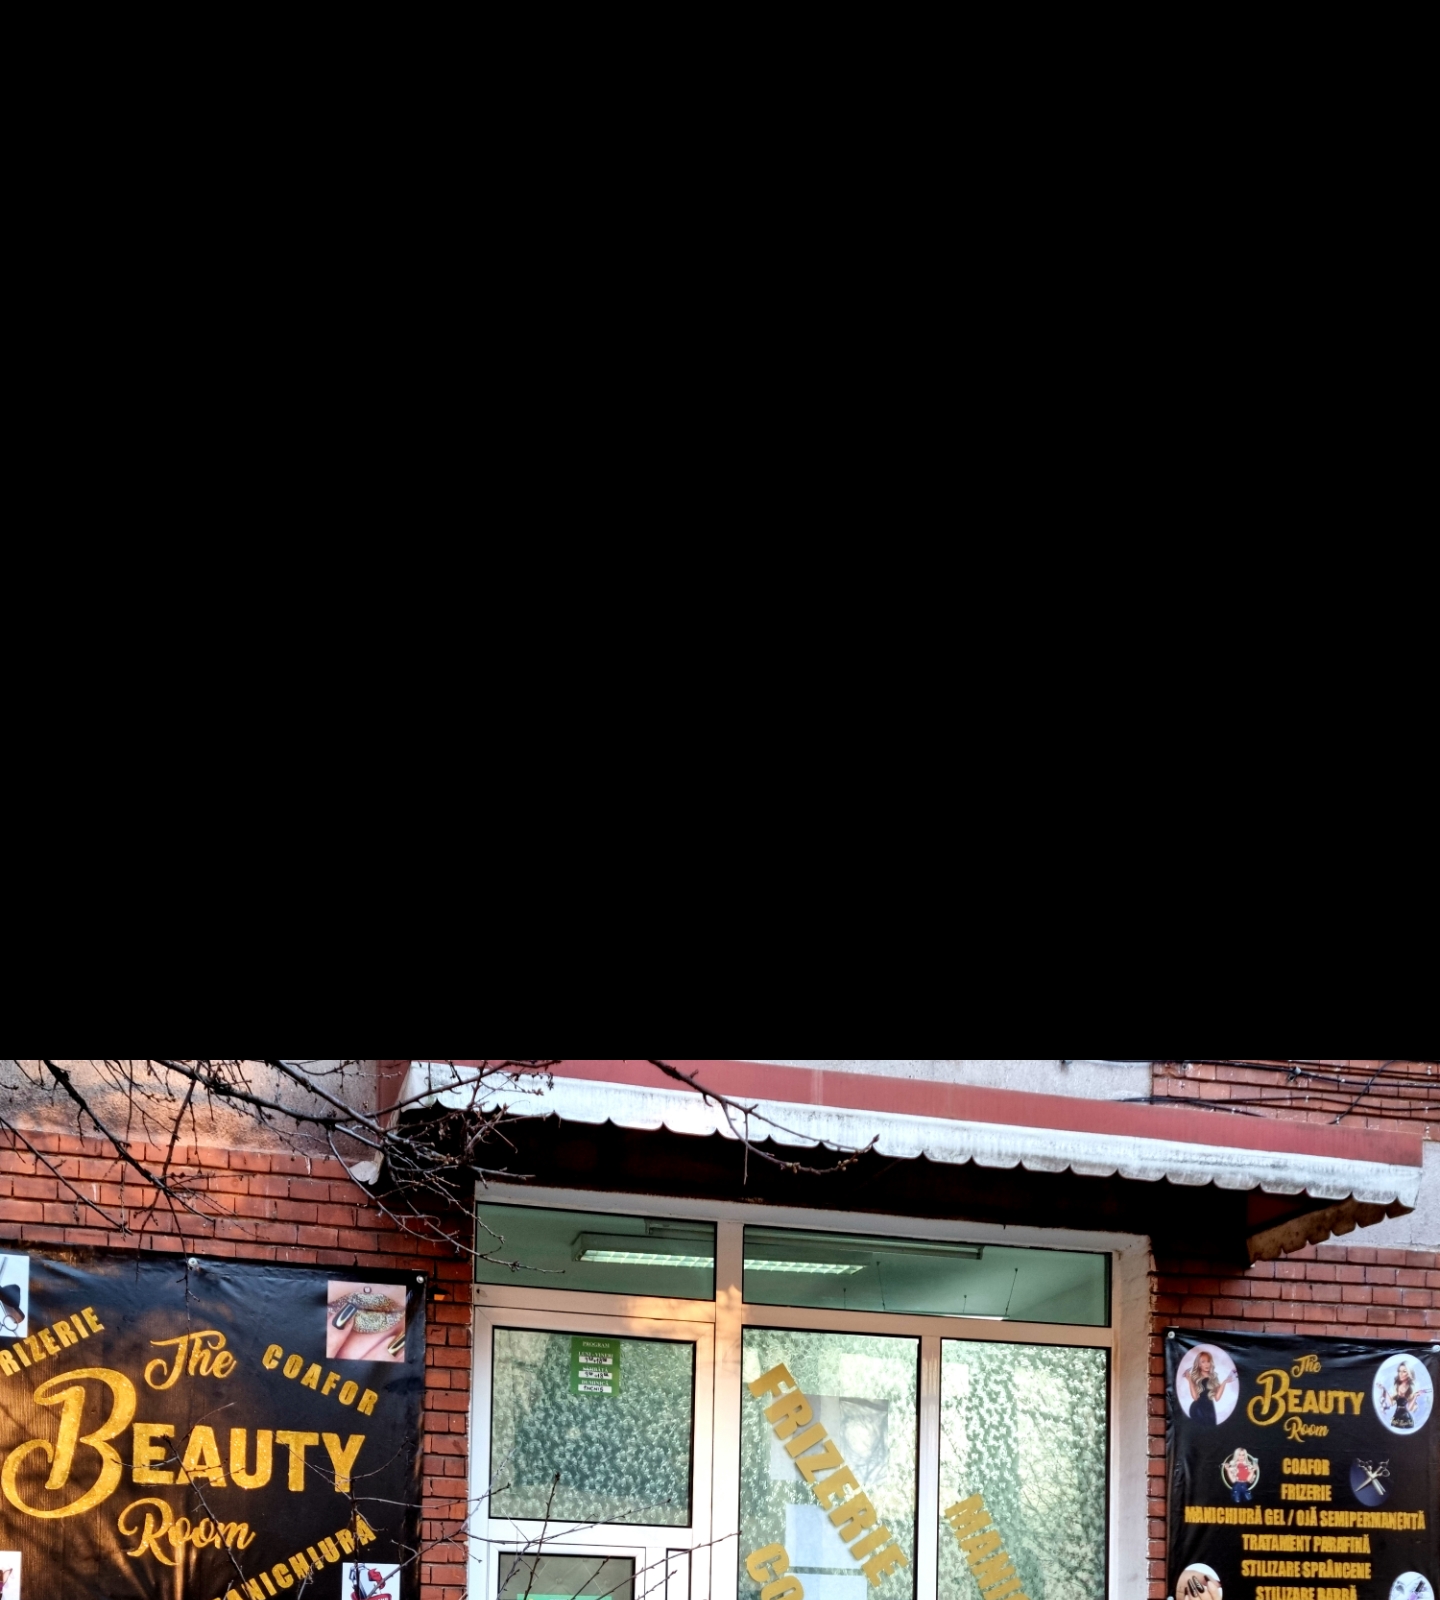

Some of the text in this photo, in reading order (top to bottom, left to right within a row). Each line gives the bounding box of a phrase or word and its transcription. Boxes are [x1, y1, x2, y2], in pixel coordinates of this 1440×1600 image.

[0, 1306, 105, 1377] RIZERIE
[144, 1330, 237, 1390] The
[261, 1343, 379, 1417] COAFOR
[1290, 1354, 1322, 1378] The
[1247, 1369, 1365, 1426] BEAUTY
[1, 1367, 366, 1519] BEAUTY
[1283, 1416, 1329, 1443] Room
[748, 1362, 908, 1587] FRIZERIE
[1282, 1458, 1330, 1476] COAFOR
[1281, 1484, 1332, 1502] FRIZERIE
[117, 1497, 256, 1566] Room
[1184, 1505, 1426, 1530] MANICHIURĂ GEL / OJĂ SEMIPERMANENTĂ
[1242, 1533, 1371, 1554] TRATAMENT PARAFINĂ
[1241, 1558, 1372, 1580] STILIZARE SPRÂNCENE
